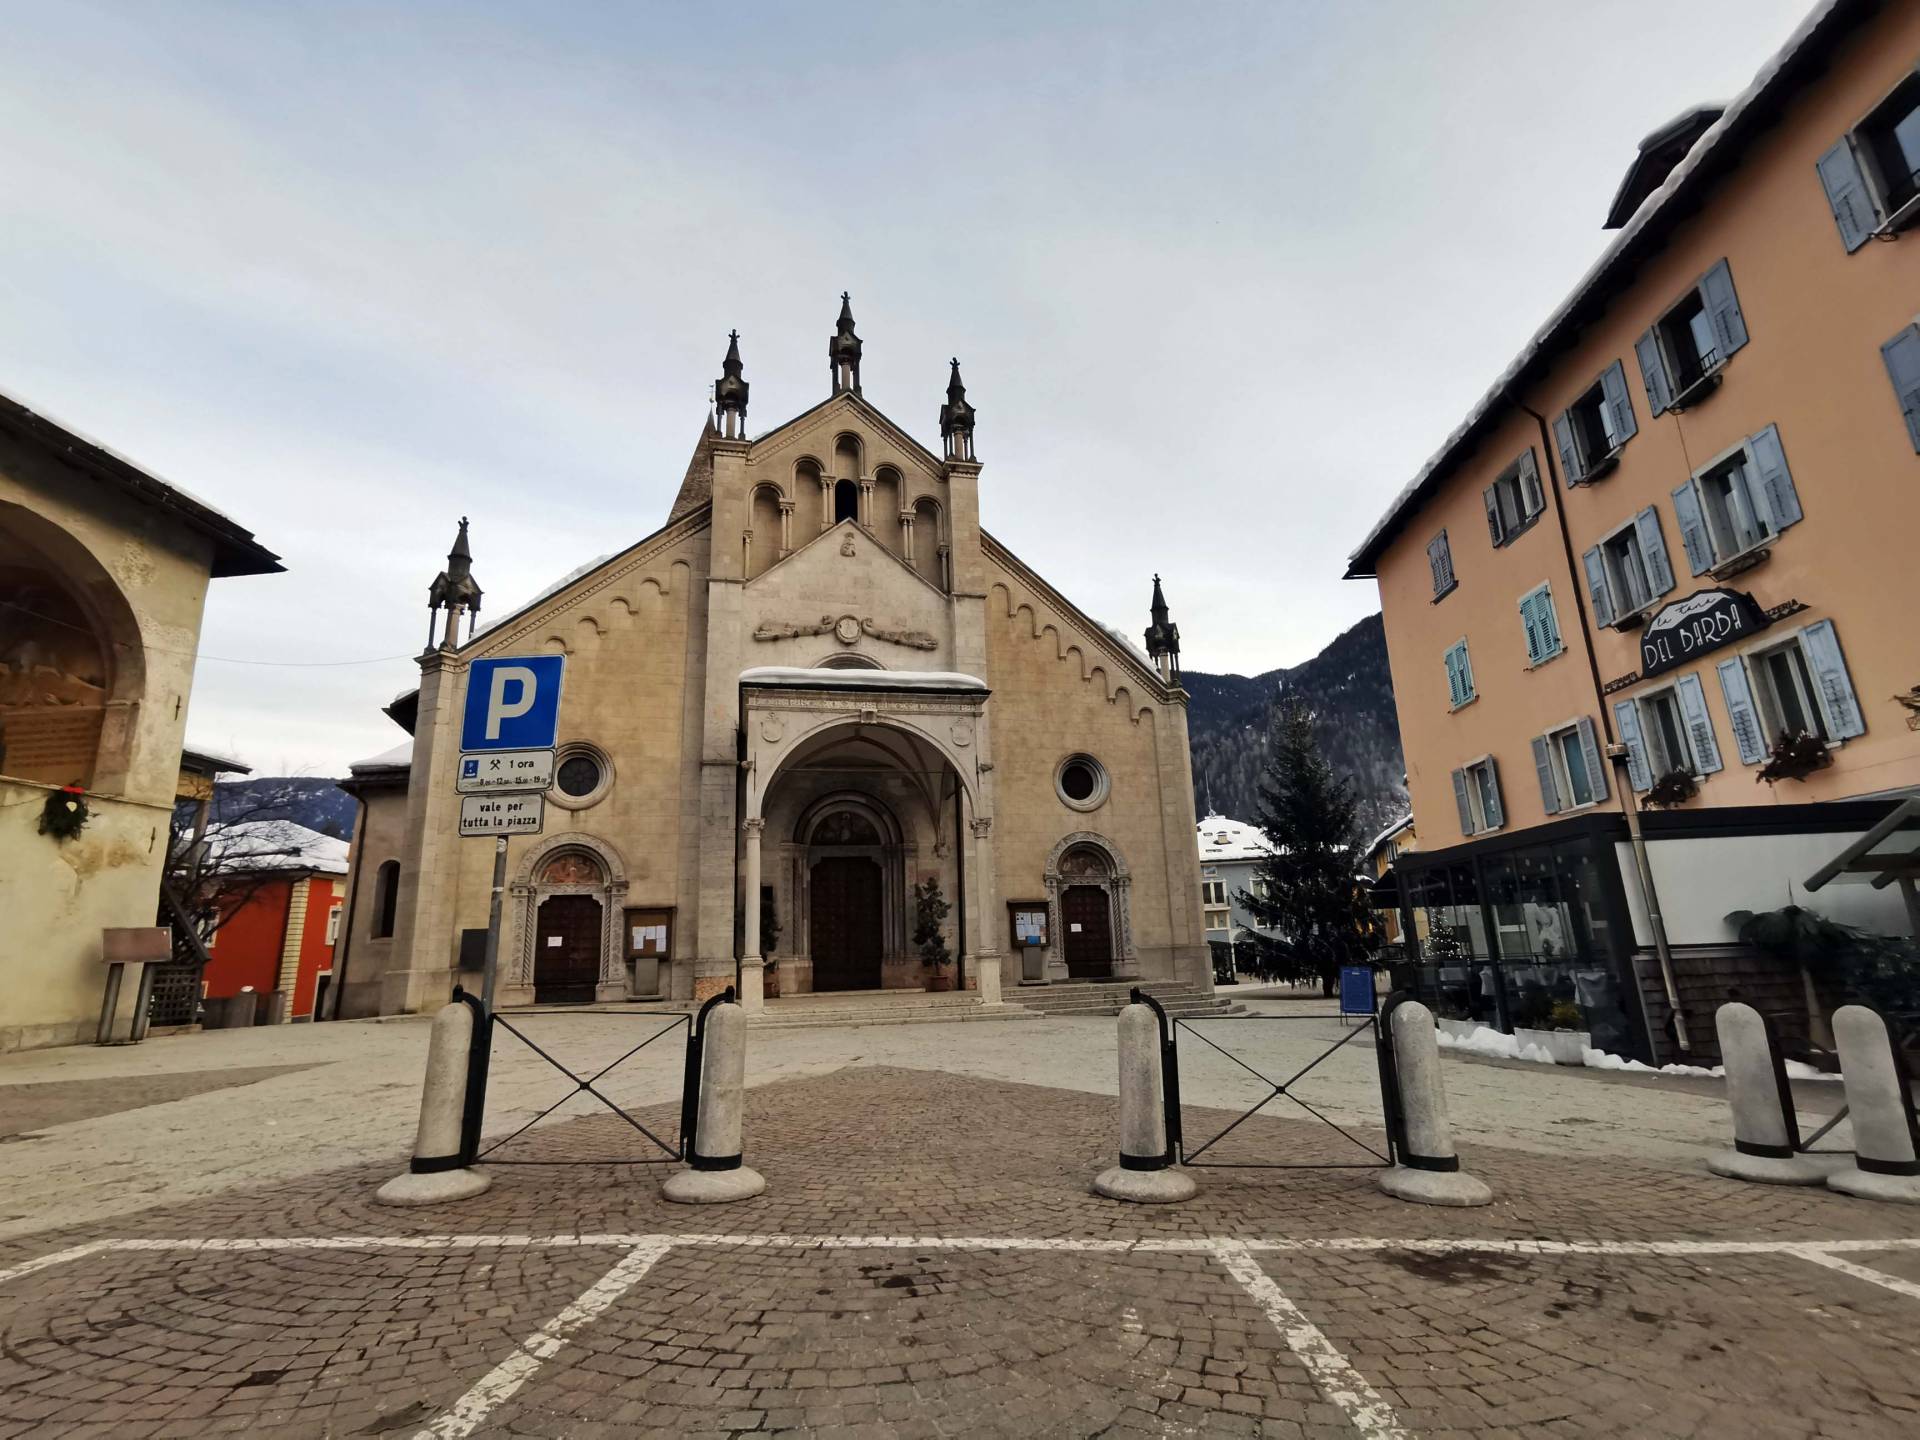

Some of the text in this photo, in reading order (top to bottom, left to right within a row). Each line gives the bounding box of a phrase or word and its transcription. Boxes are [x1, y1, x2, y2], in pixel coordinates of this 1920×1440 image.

[1643, 603, 1742, 669] DEL BARBA
[485, 666, 537, 740] P
[517, 760, 535, 768] ora
[480, 801, 523, 813] vale per
[463, 815, 537, 828] tutta la piazza
